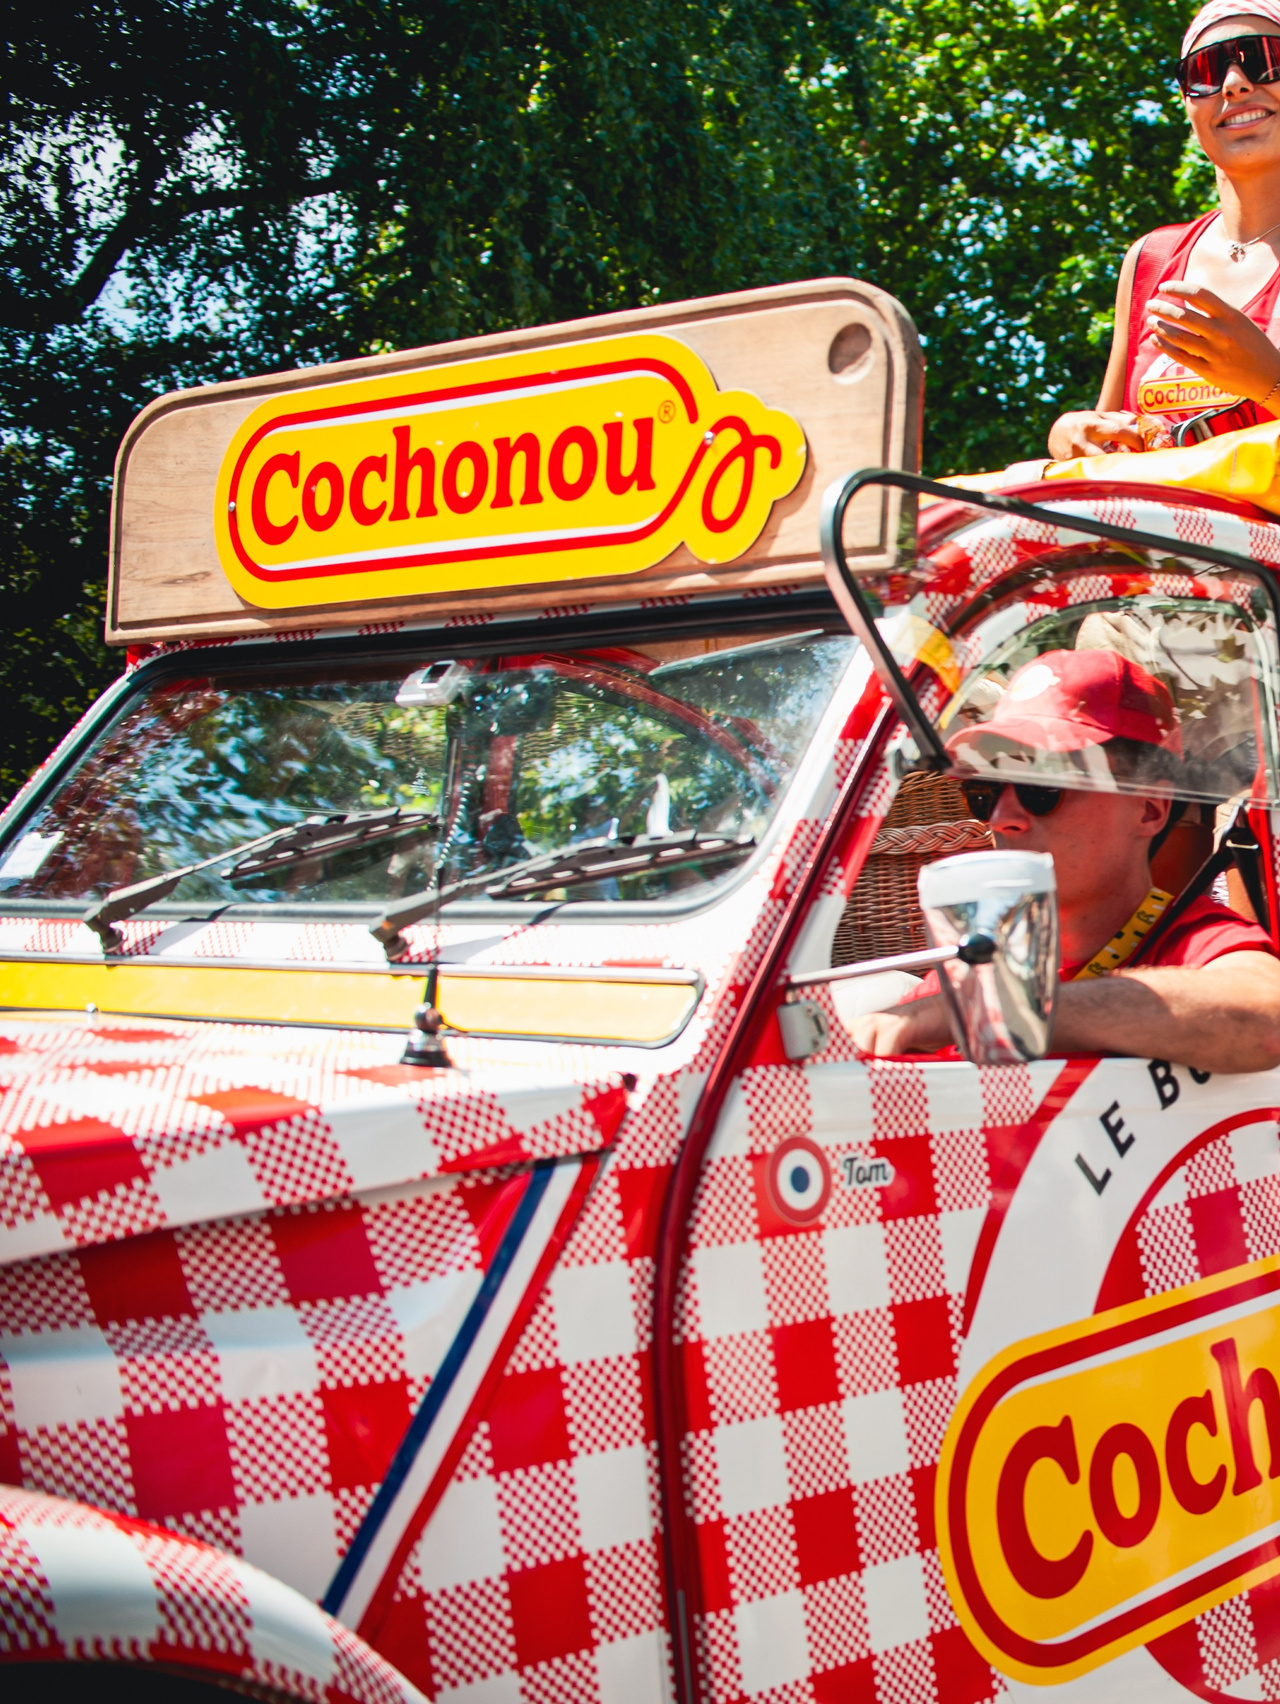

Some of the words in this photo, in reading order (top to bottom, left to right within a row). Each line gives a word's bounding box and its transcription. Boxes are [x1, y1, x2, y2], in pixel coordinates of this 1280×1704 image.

[1143, 383, 1235, 408] Cochono
[251, 417, 656, 546] Cochonou
[1075, 1100, 1136, 1196] LE
